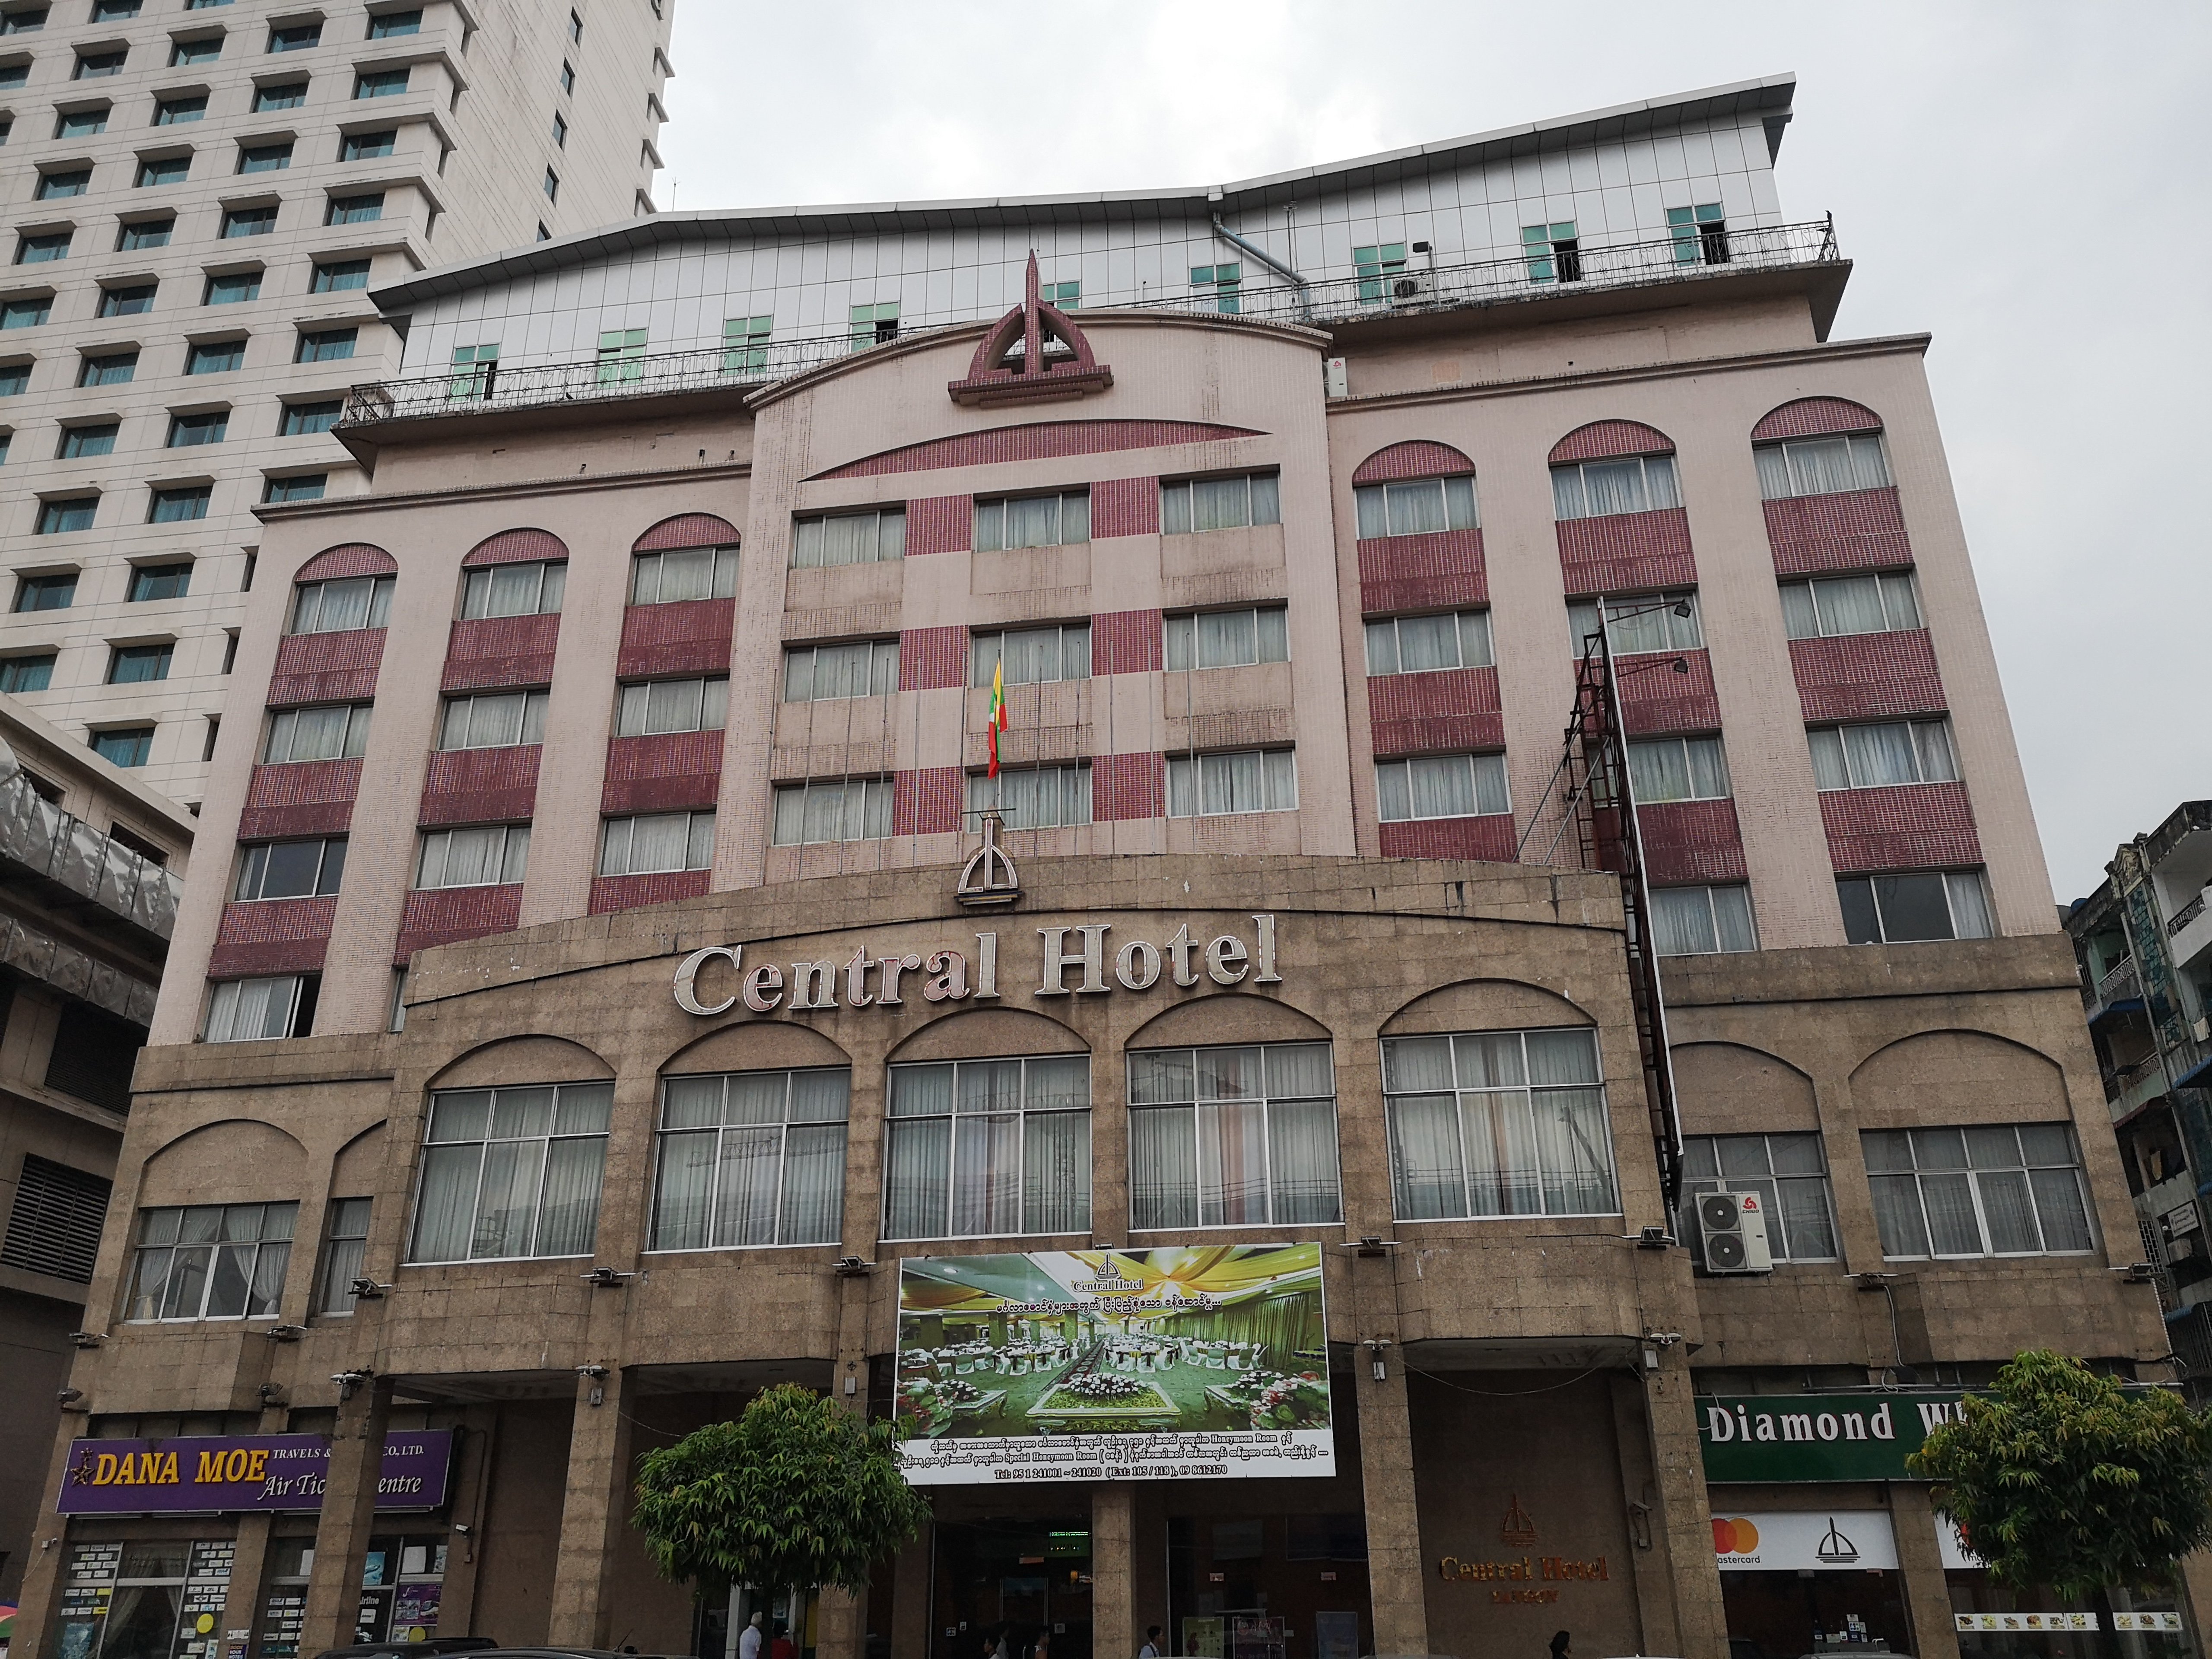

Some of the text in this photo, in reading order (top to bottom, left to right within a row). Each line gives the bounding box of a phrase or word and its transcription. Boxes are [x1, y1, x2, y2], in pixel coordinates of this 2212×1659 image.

[673, 914, 1284, 1015] Central Hotel
[1073, 1278, 1144, 1292] Central Hotel
[1707, 1402, 1896, 1442] Diamond
[1211, 1434, 1253, 1445] Honeymoon
[1255, 1433, 1278, 1443] Room
[92, 1451, 180, 1486] DANA
[194, 1449, 270, 1483] MOE
[273, 1448, 321, 1459] TRAVELS
[402, 1445, 424, 1456] LTD.
[1004, 1452, 1030, 1464] Special
[1032, 1452, 1074, 1463] Honeymoon
[1076, 1451, 1097, 1460] Room
[995, 1469, 1011, 1479] Tel:
[1013, 1468, 1024, 1478] 95
[1025, 1468, 1031, 1478] 1
[1032, 1468, 1062, 1478] 241001
[1071, 1467, 1102, 1477] 241020
[1111, 1466, 1130, 1476] Ext:
[1132, 1466, 1147, 1476] 105
[1154, 1465, 1170, 1476] 118
[1179, 1465, 1190, 1475] 09
[1192, 1465, 1228, 1475] 8612170
[257, 1471, 422, 1501] Air Tic entre
[1440, 1556, 1610, 1582] Central Hotel
[1717, 1555, 1761, 1564] astercard
